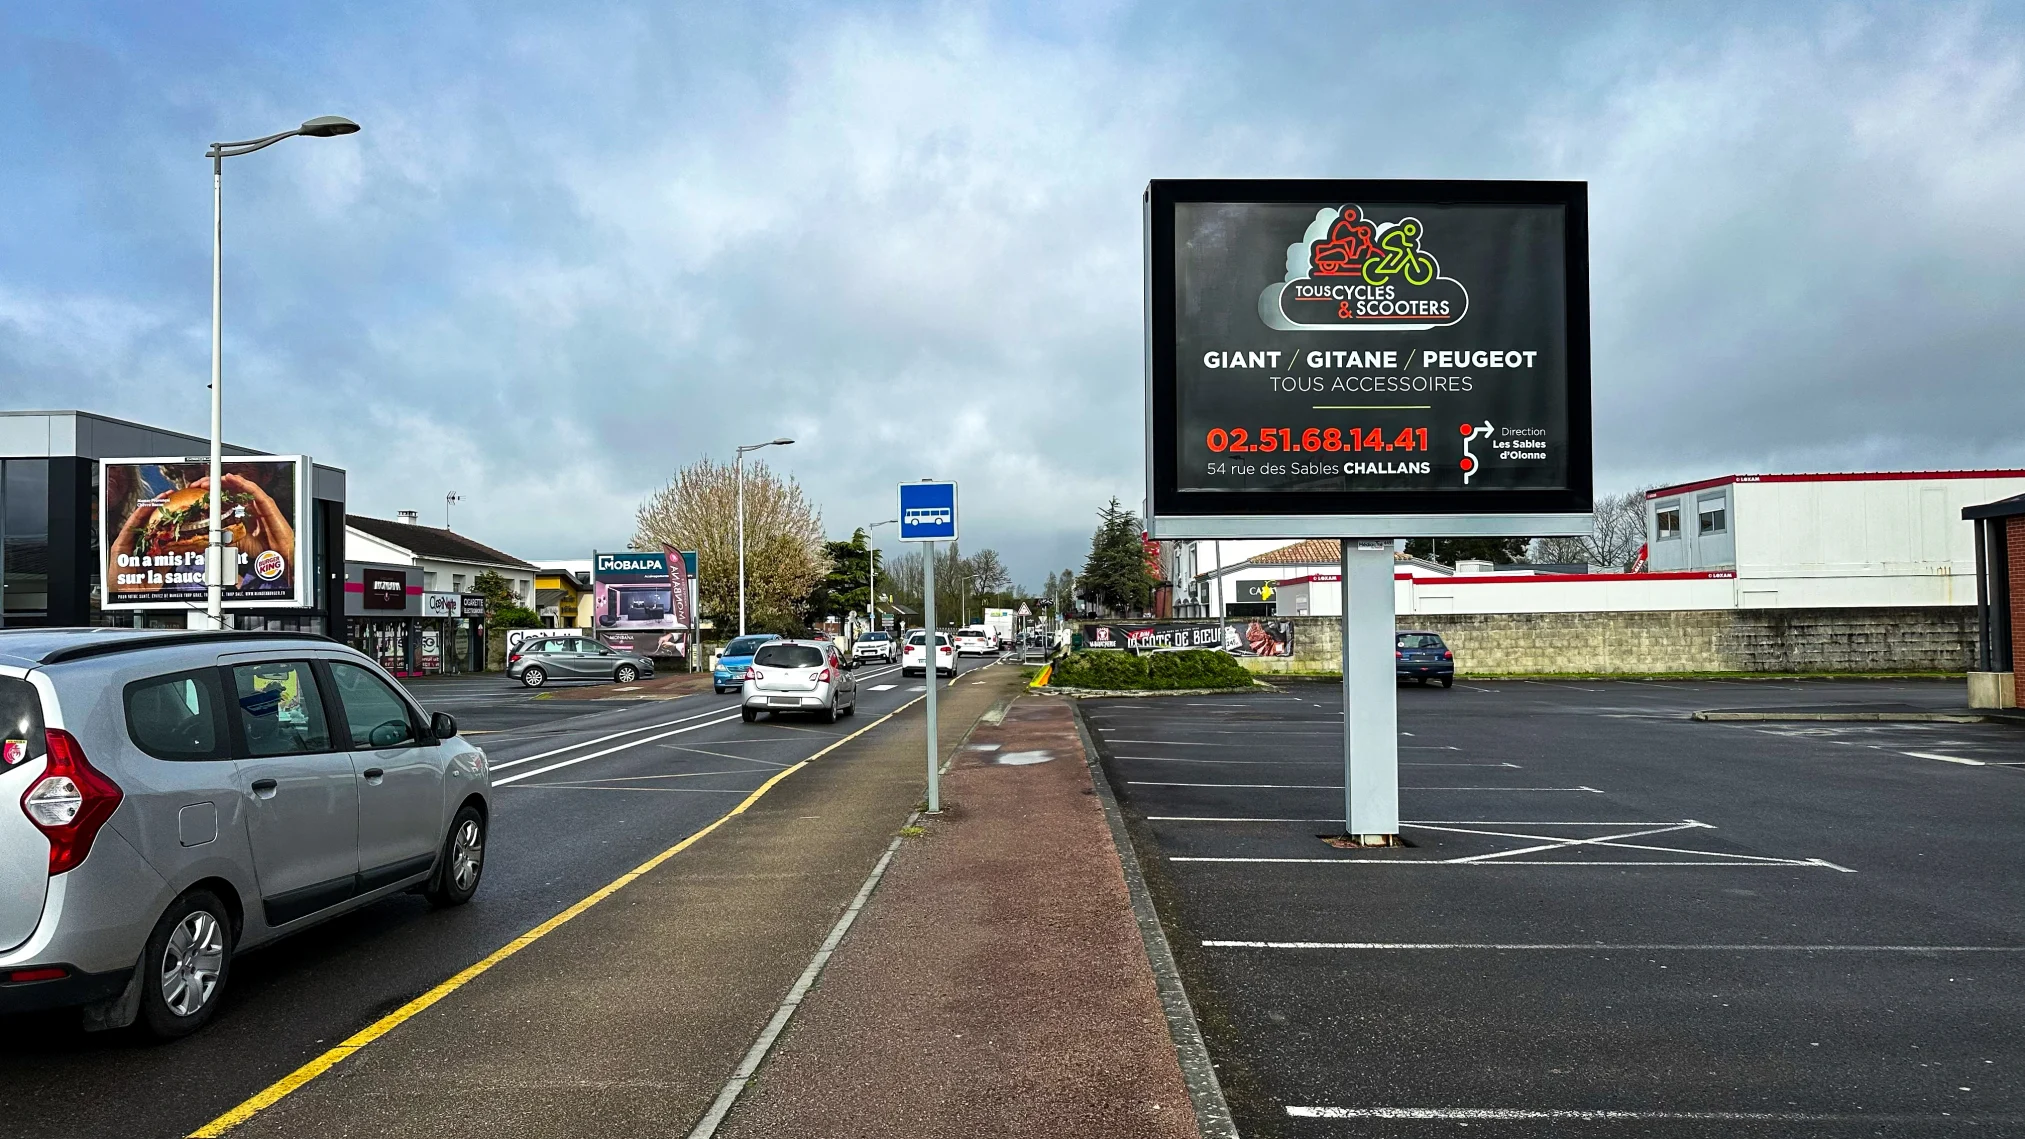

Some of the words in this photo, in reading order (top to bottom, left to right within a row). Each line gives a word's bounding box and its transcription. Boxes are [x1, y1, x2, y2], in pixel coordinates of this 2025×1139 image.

[1295, 285, 1331, 297] TOUS
[1332, 285, 1395, 300] CYCLES
[1338, 300, 1353, 319] &
[1356, 300, 1450, 315] SCOOTERS
[1203, 350, 1282, 369] GIANT
[1306, 350, 1398, 369] GITANE
[1423, 350, 1538, 369] PEUGEOT
[1270, 376, 1324, 392] TOUS
[1331, 376, 1473, 392] ACCESSOIRES
[1501, 427, 1546, 436] Direction
[1206, 427, 1428, 452] 02.51.68.14.41
[1492, 440, 1511, 449] Les
[1512, 439, 1547, 449] Sables
[1500, 450, 1547, 460] d'Olonne
[1207, 462, 1226, 475] 54
[1231, 465, 1255, 475] rue
[1260, 462, 1286, 475] des
[1290, 462, 1339, 475] Sables
[1343, 461, 1431, 475] CHALLANS
[117, 553, 140, 567] On
[142, 555, 152, 567] a
[154, 551, 183, 567] mis
[258, 556, 280, 567] BURGER
[604, 560, 663, 570] MOBALPA
[259, 562, 281, 574] KING
[117, 573, 145, 584] sur
[147, 570, 163, 584] la
[1175, 634, 1189, 648] DE
